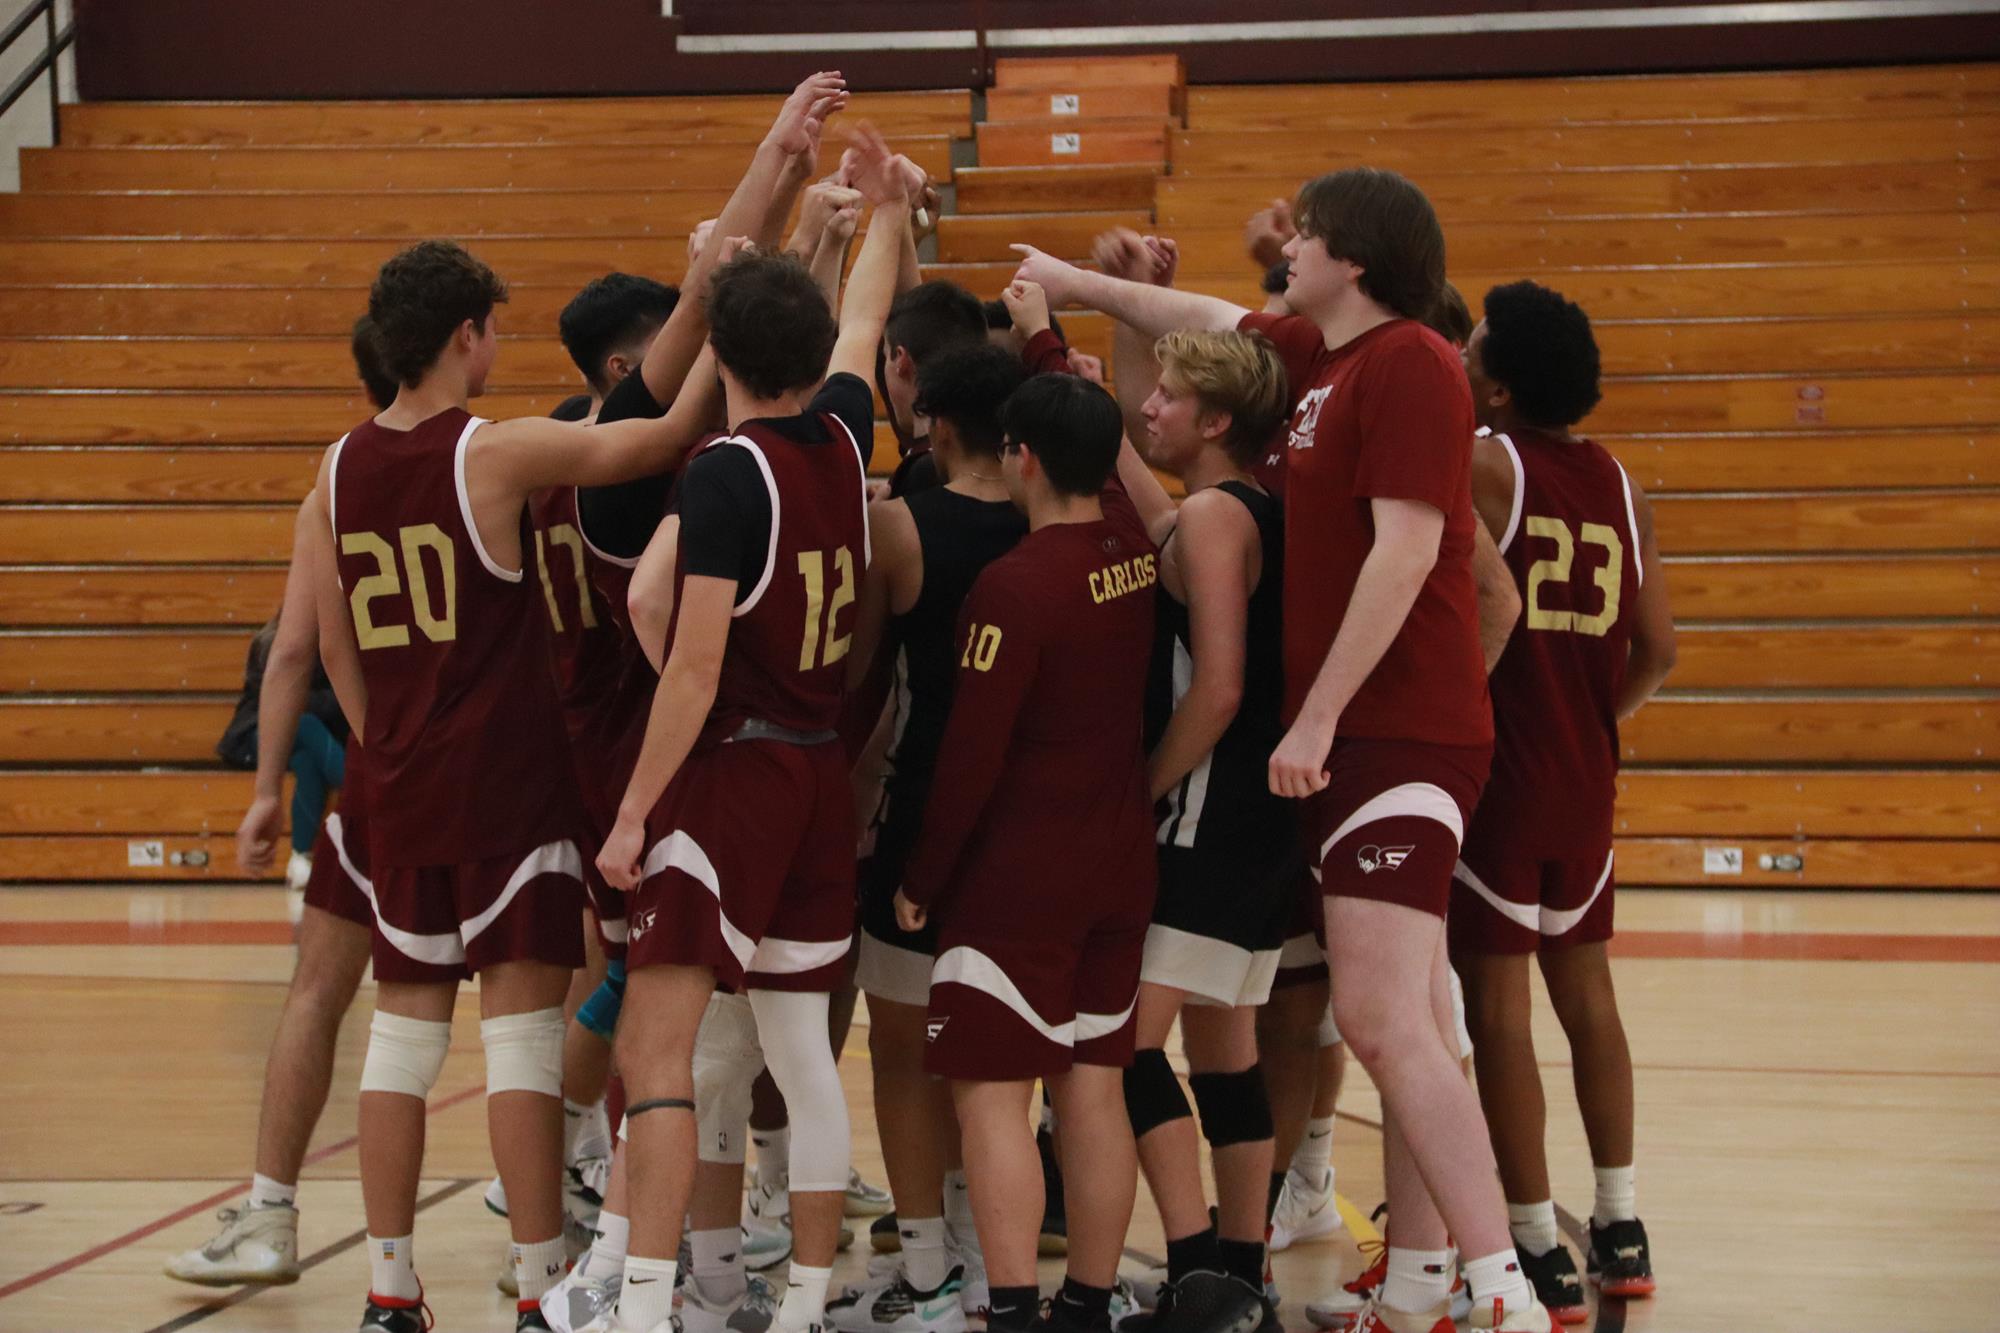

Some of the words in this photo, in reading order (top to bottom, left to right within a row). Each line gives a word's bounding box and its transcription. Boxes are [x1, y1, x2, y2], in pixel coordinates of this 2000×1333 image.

[341, 523, 456, 650] 20
[797, 544, 855, 672] 12
[1088, 553, 1157, 604] CARLOS
[1526, 515, 1623, 637] 23
